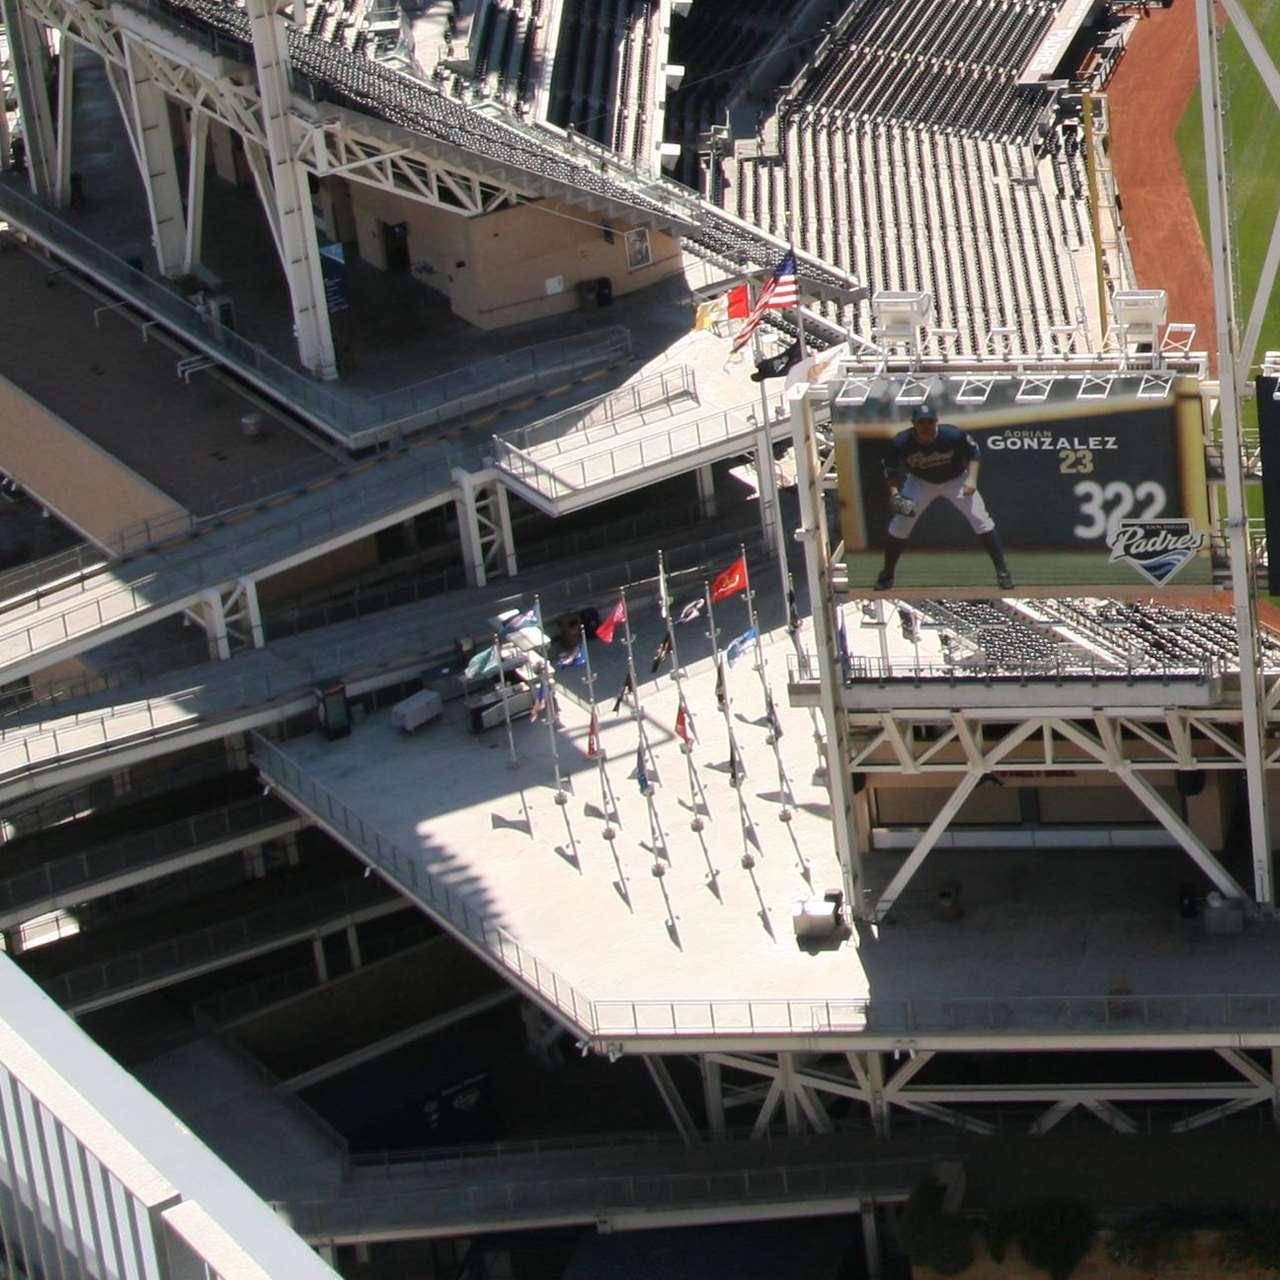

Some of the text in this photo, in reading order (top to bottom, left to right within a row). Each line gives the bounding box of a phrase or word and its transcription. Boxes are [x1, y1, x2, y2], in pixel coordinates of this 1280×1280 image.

[986, 435, 1119, 450] GONZALEZ
[1004, 430, 1052, 439] ADRIAN
[1058, 450, 1095, 474] 23
[1109, 526, 1205, 563] Padres
